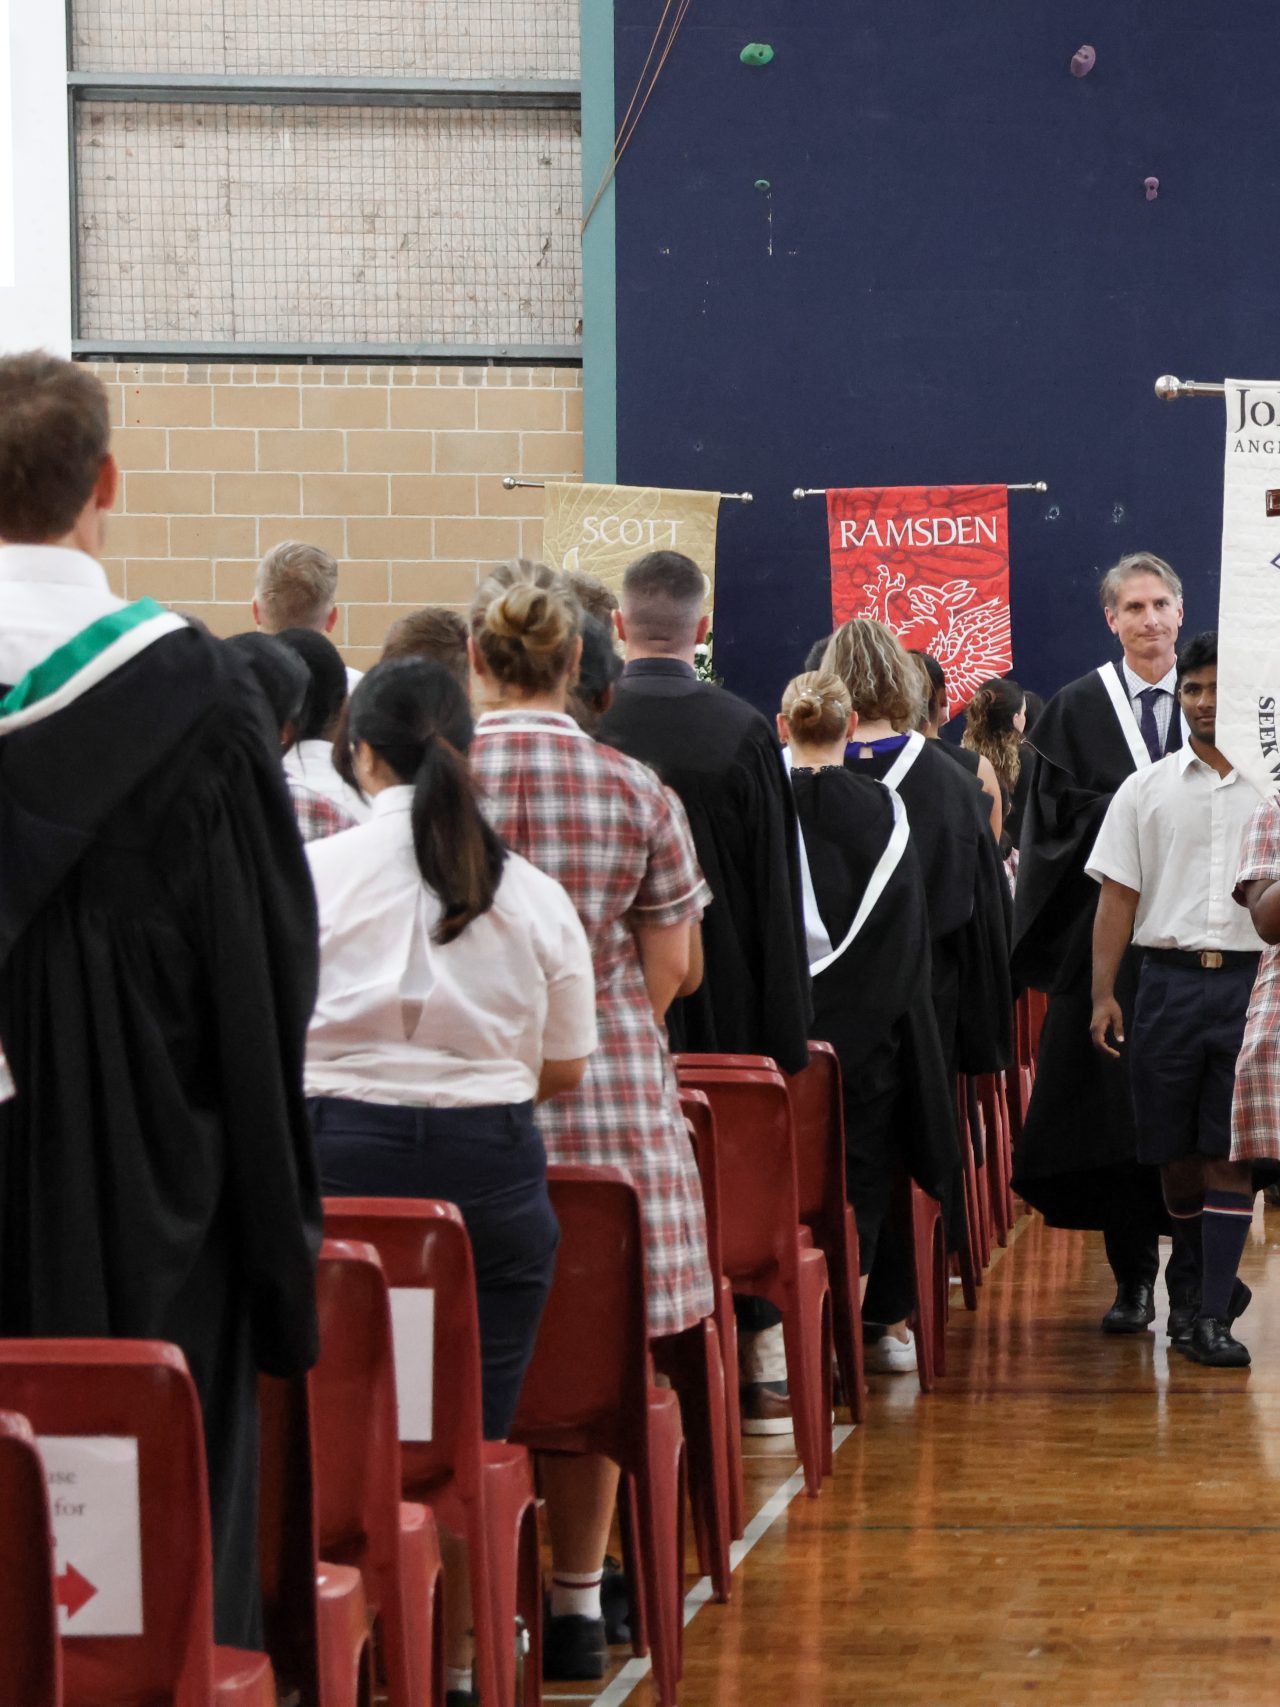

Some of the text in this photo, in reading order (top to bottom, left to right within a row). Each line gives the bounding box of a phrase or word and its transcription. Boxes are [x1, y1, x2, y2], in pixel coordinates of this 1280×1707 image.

[582, 515, 685, 545] SCOTT
[840, 516, 997, 548] RAMSDEN
[1258, 696, 1280, 758] SEEK
[54, 1498, 86, 1517] for
